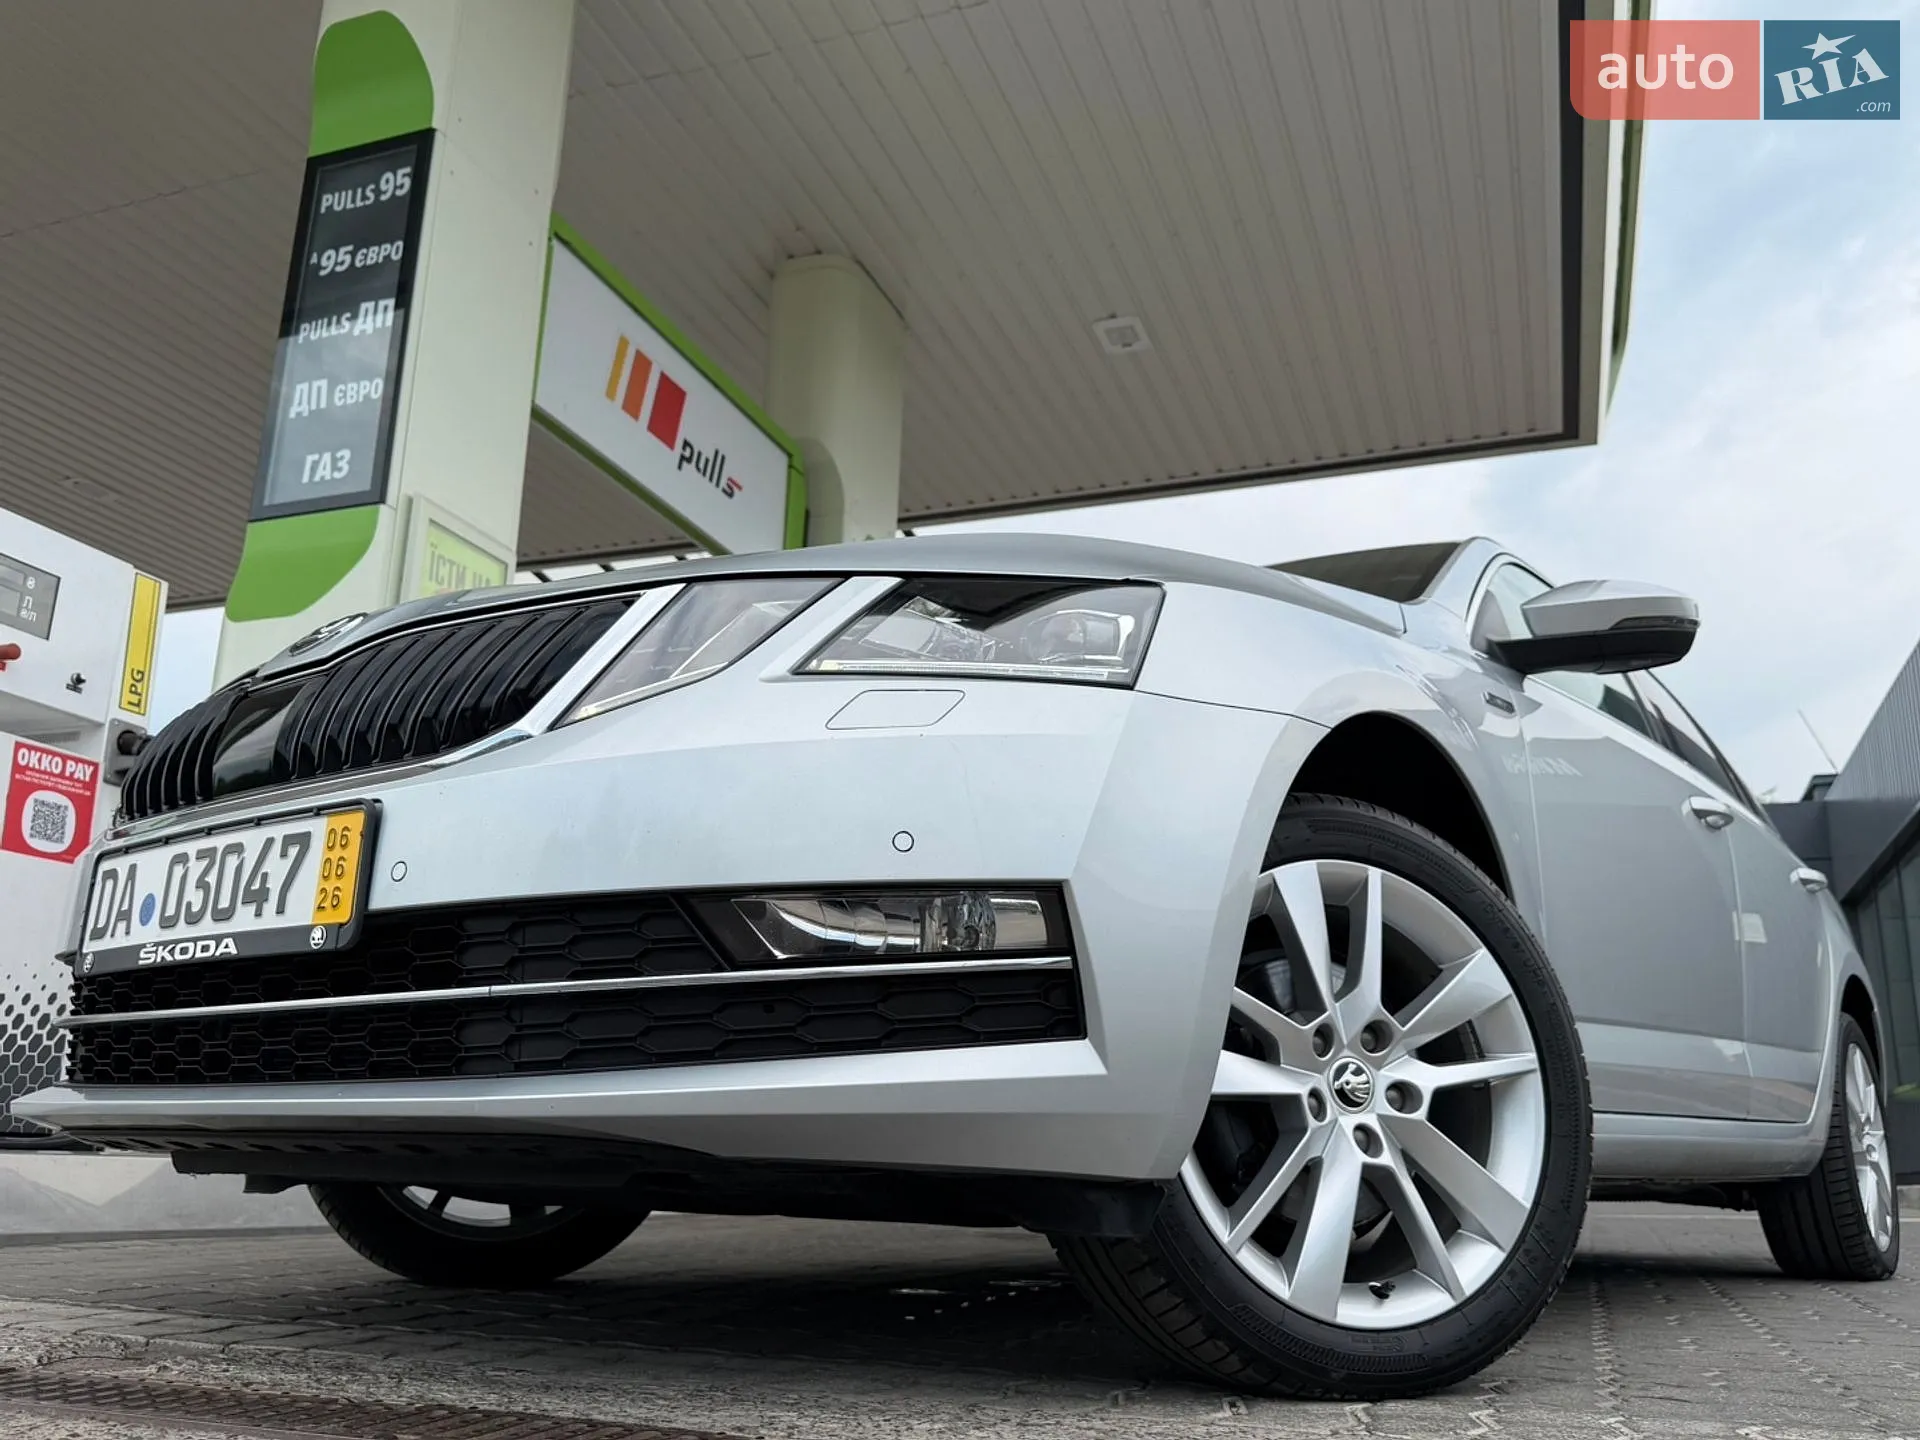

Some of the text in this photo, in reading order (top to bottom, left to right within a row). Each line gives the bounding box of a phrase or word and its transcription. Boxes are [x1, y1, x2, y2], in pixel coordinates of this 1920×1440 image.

[320, 167, 412, 214] PULLS 95
[354, 240, 404, 269] ЄВРО
[298, 298, 396, 344] PULLS ДП
[289, 377, 384, 419] ДП ЄВРО
[301, 449, 352, 484] ГАЗ
[677, 436, 743, 499] pulls
[127, 668, 145, 708] LPG
[17, 747, 63, 774] OKKO
[65, 759, 94, 782] PAY
[326, 826, 352, 851] 06
[89, 831, 312, 941] DA 03047
[321, 856, 347, 881] 06
[316, 887, 341, 912] 26
[138, 937, 238, 966] ŠKODA
